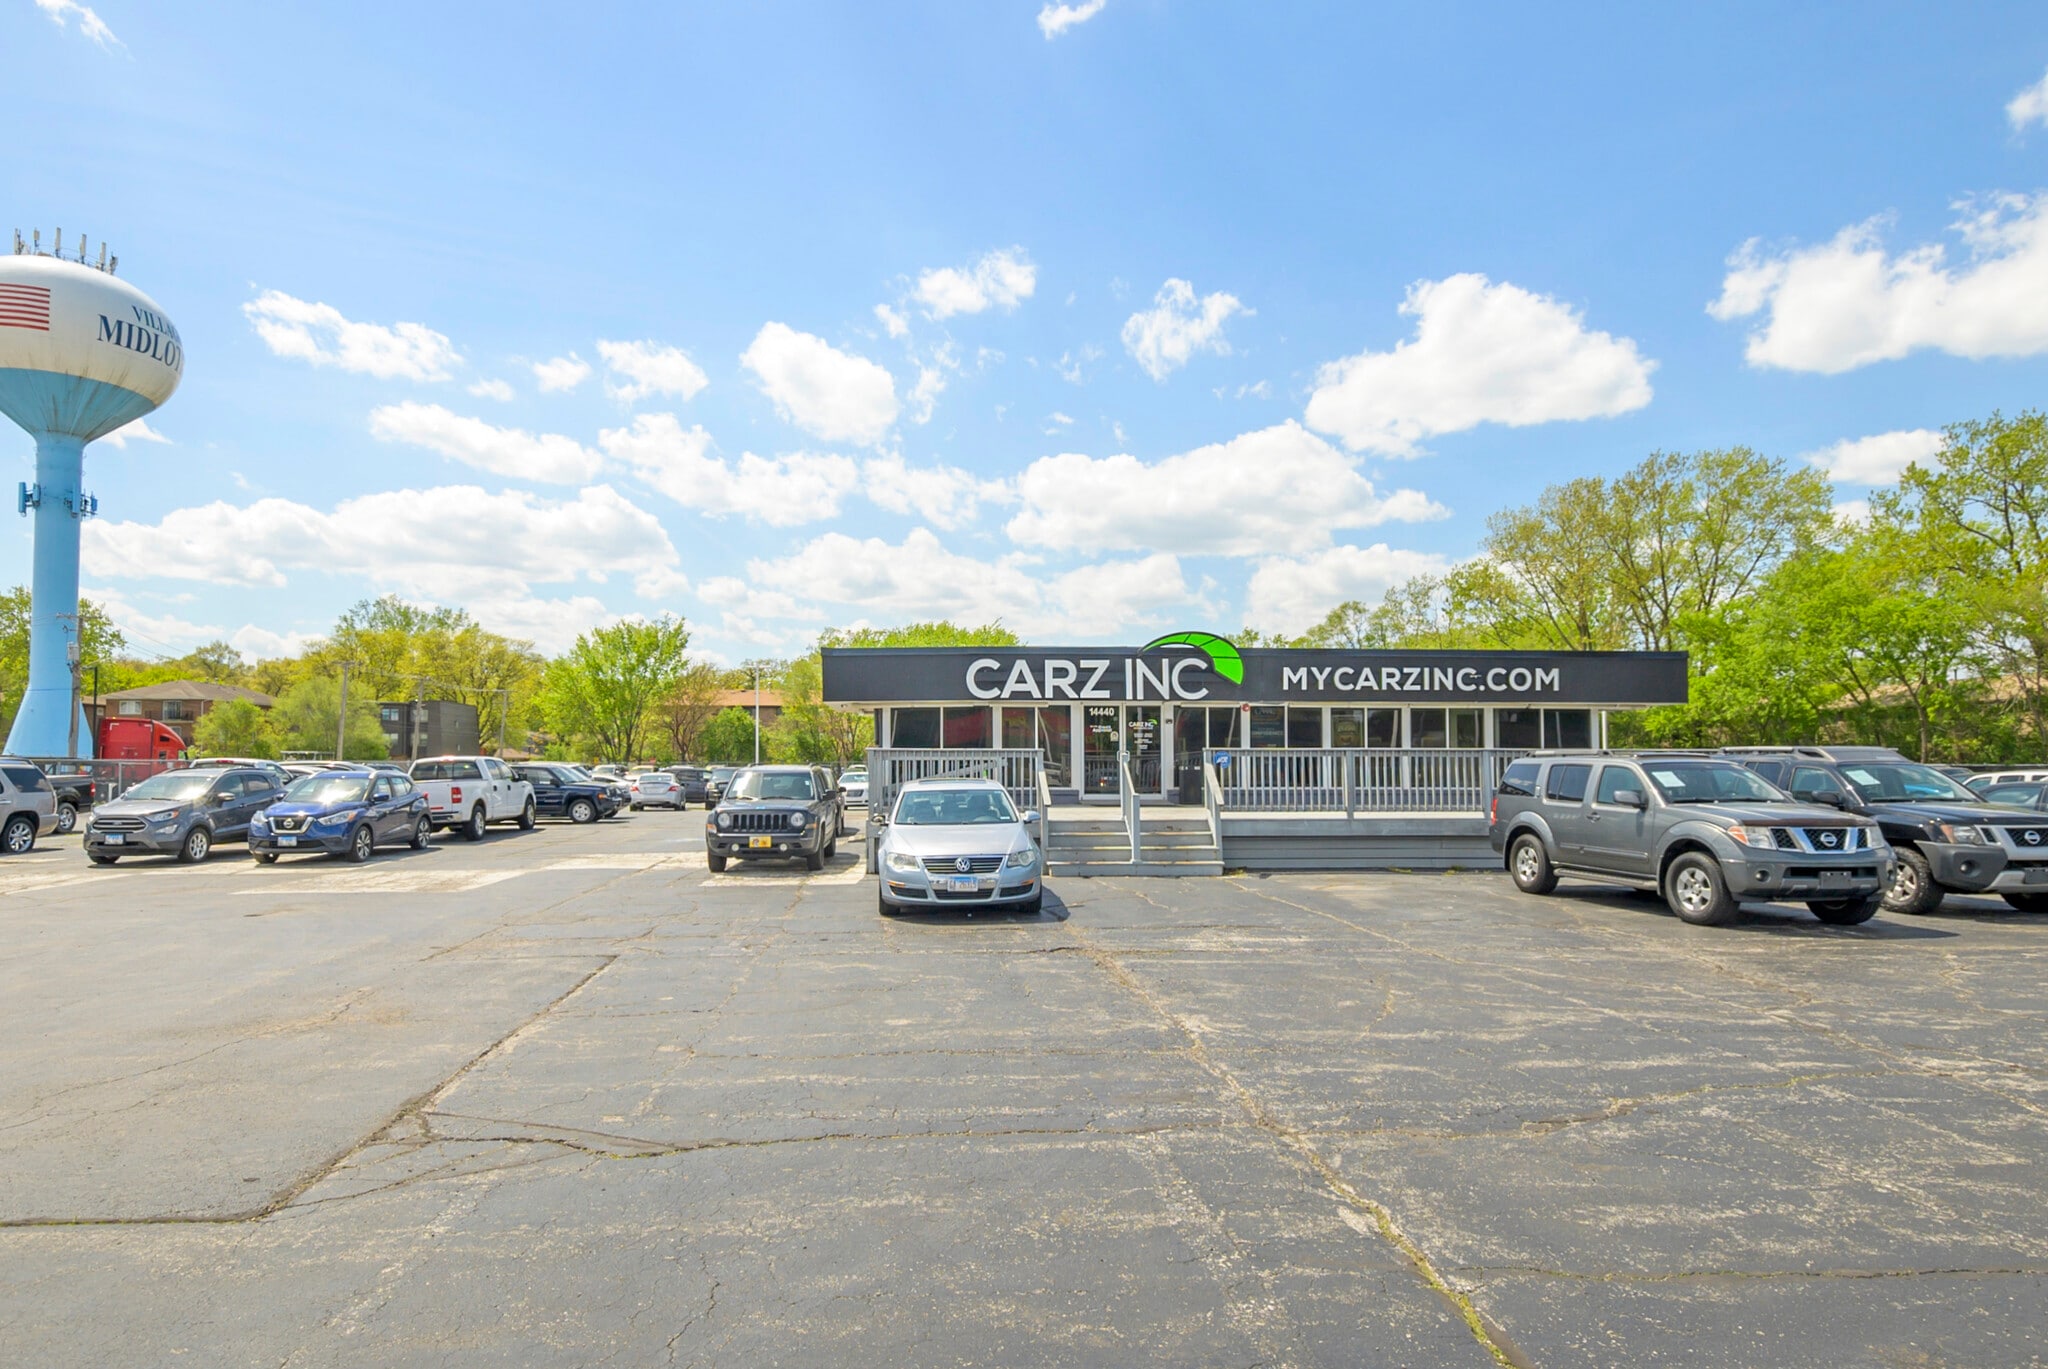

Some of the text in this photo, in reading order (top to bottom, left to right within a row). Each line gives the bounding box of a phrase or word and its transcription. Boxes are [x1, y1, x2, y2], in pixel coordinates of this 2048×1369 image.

[966, 658, 1209, 700] CARZ INC
[1282, 667, 1560, 691] MYCARZINC.COM
[1089, 707, 1115, 716] 14440
